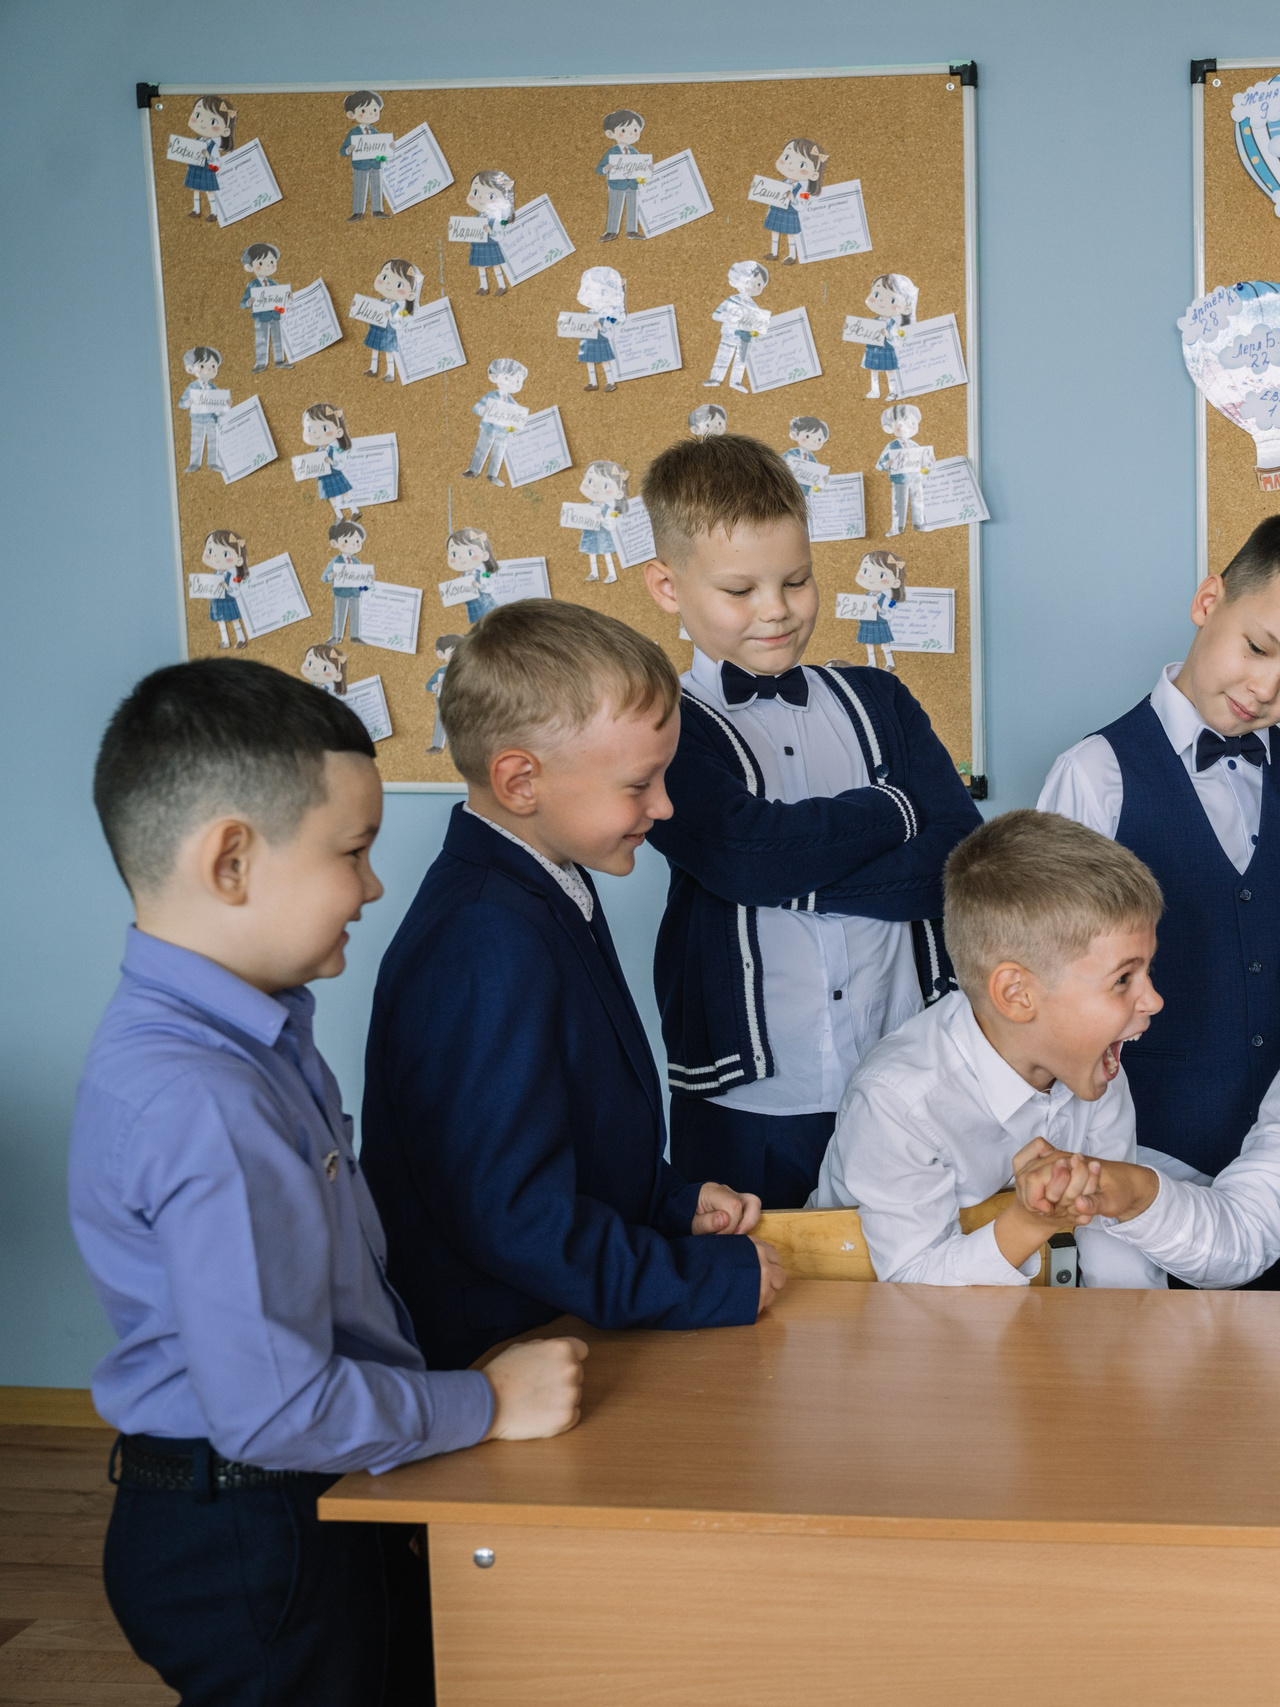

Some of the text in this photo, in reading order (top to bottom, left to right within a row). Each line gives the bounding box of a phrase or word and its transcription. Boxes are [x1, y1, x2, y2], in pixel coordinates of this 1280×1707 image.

[1260, 102, 1270, 120] 9
[611, 157, 650, 179] Андрей
[451, 219, 485, 240] Карина
[1200, 310, 1219, 335] 28
[1250, 351, 1270, 368] 22
[1268, 404, 1278, 418] 1
